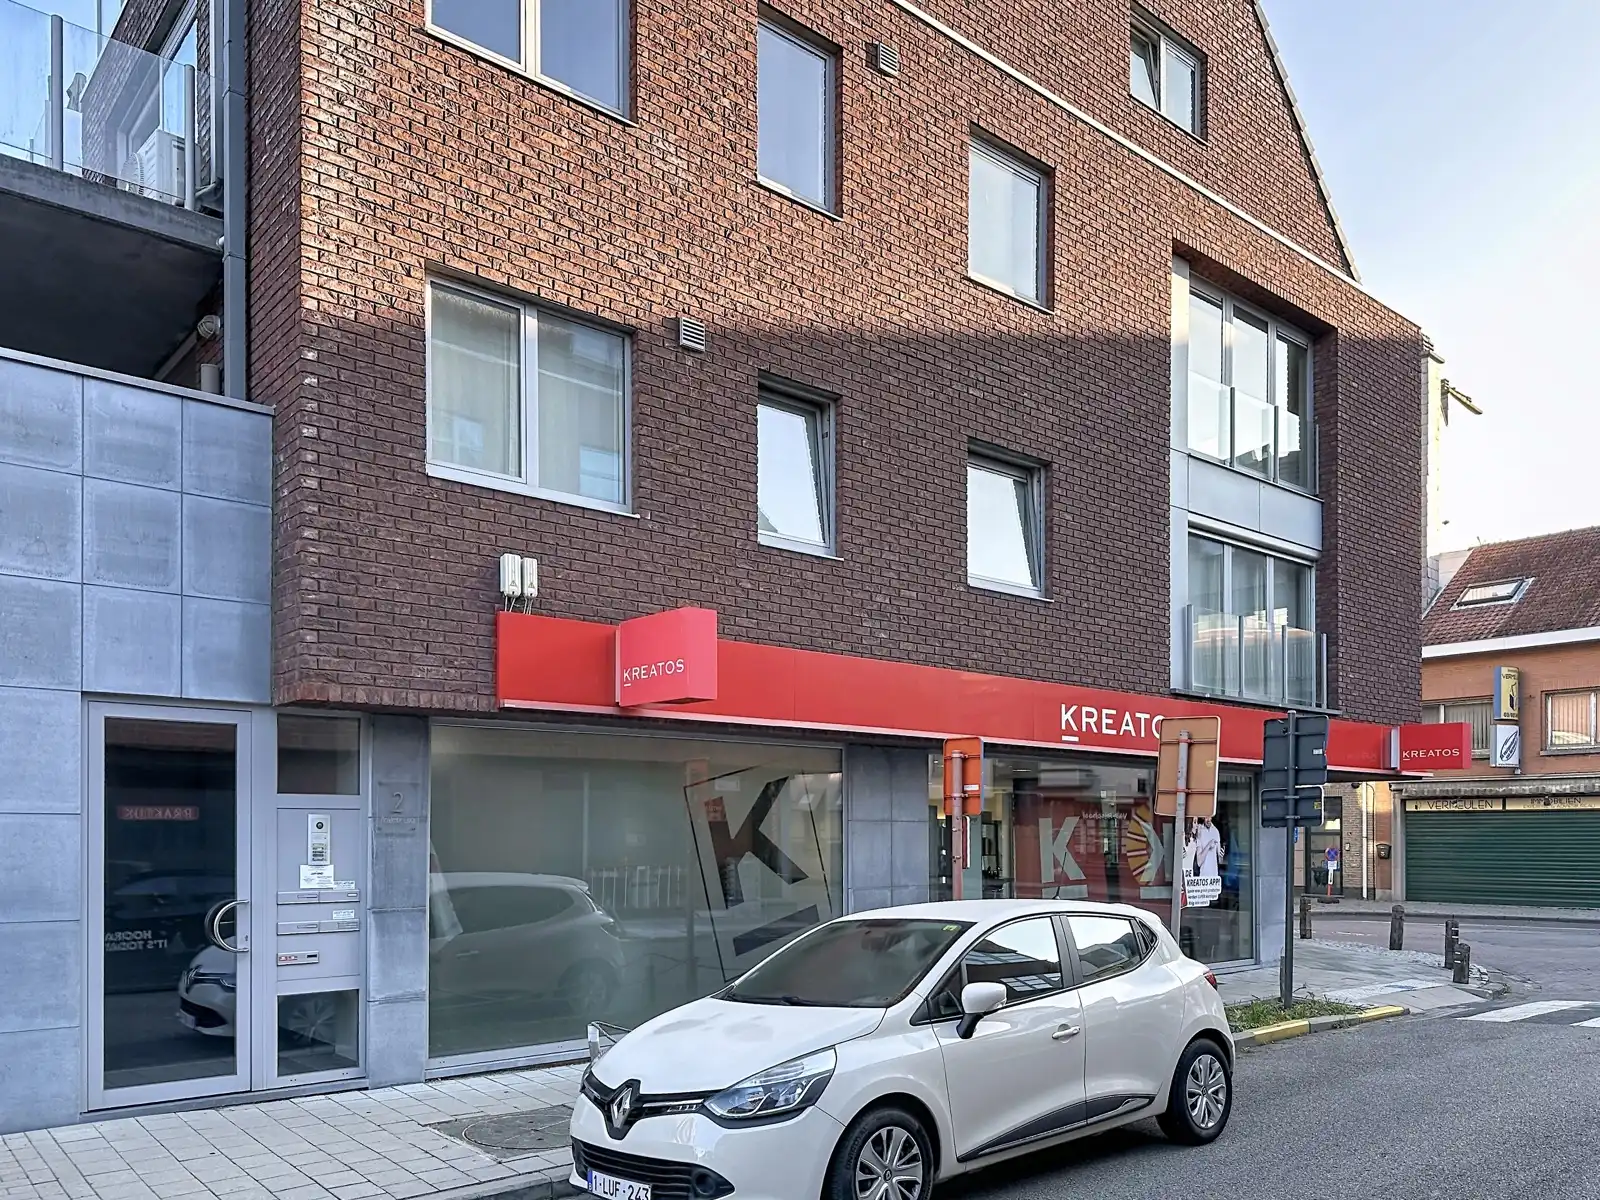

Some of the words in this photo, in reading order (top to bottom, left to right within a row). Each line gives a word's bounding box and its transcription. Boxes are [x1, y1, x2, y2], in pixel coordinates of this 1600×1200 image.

[624, 658, 685, 684] KREATOS
[1061, 703, 1166, 739] KREATO
[1402, 748, 1460, 758] KREATOS
[390, 791, 404, 814] 2
[1185, 869, 1192, 877] DE
[1209, 878, 1220, 886] APP!
